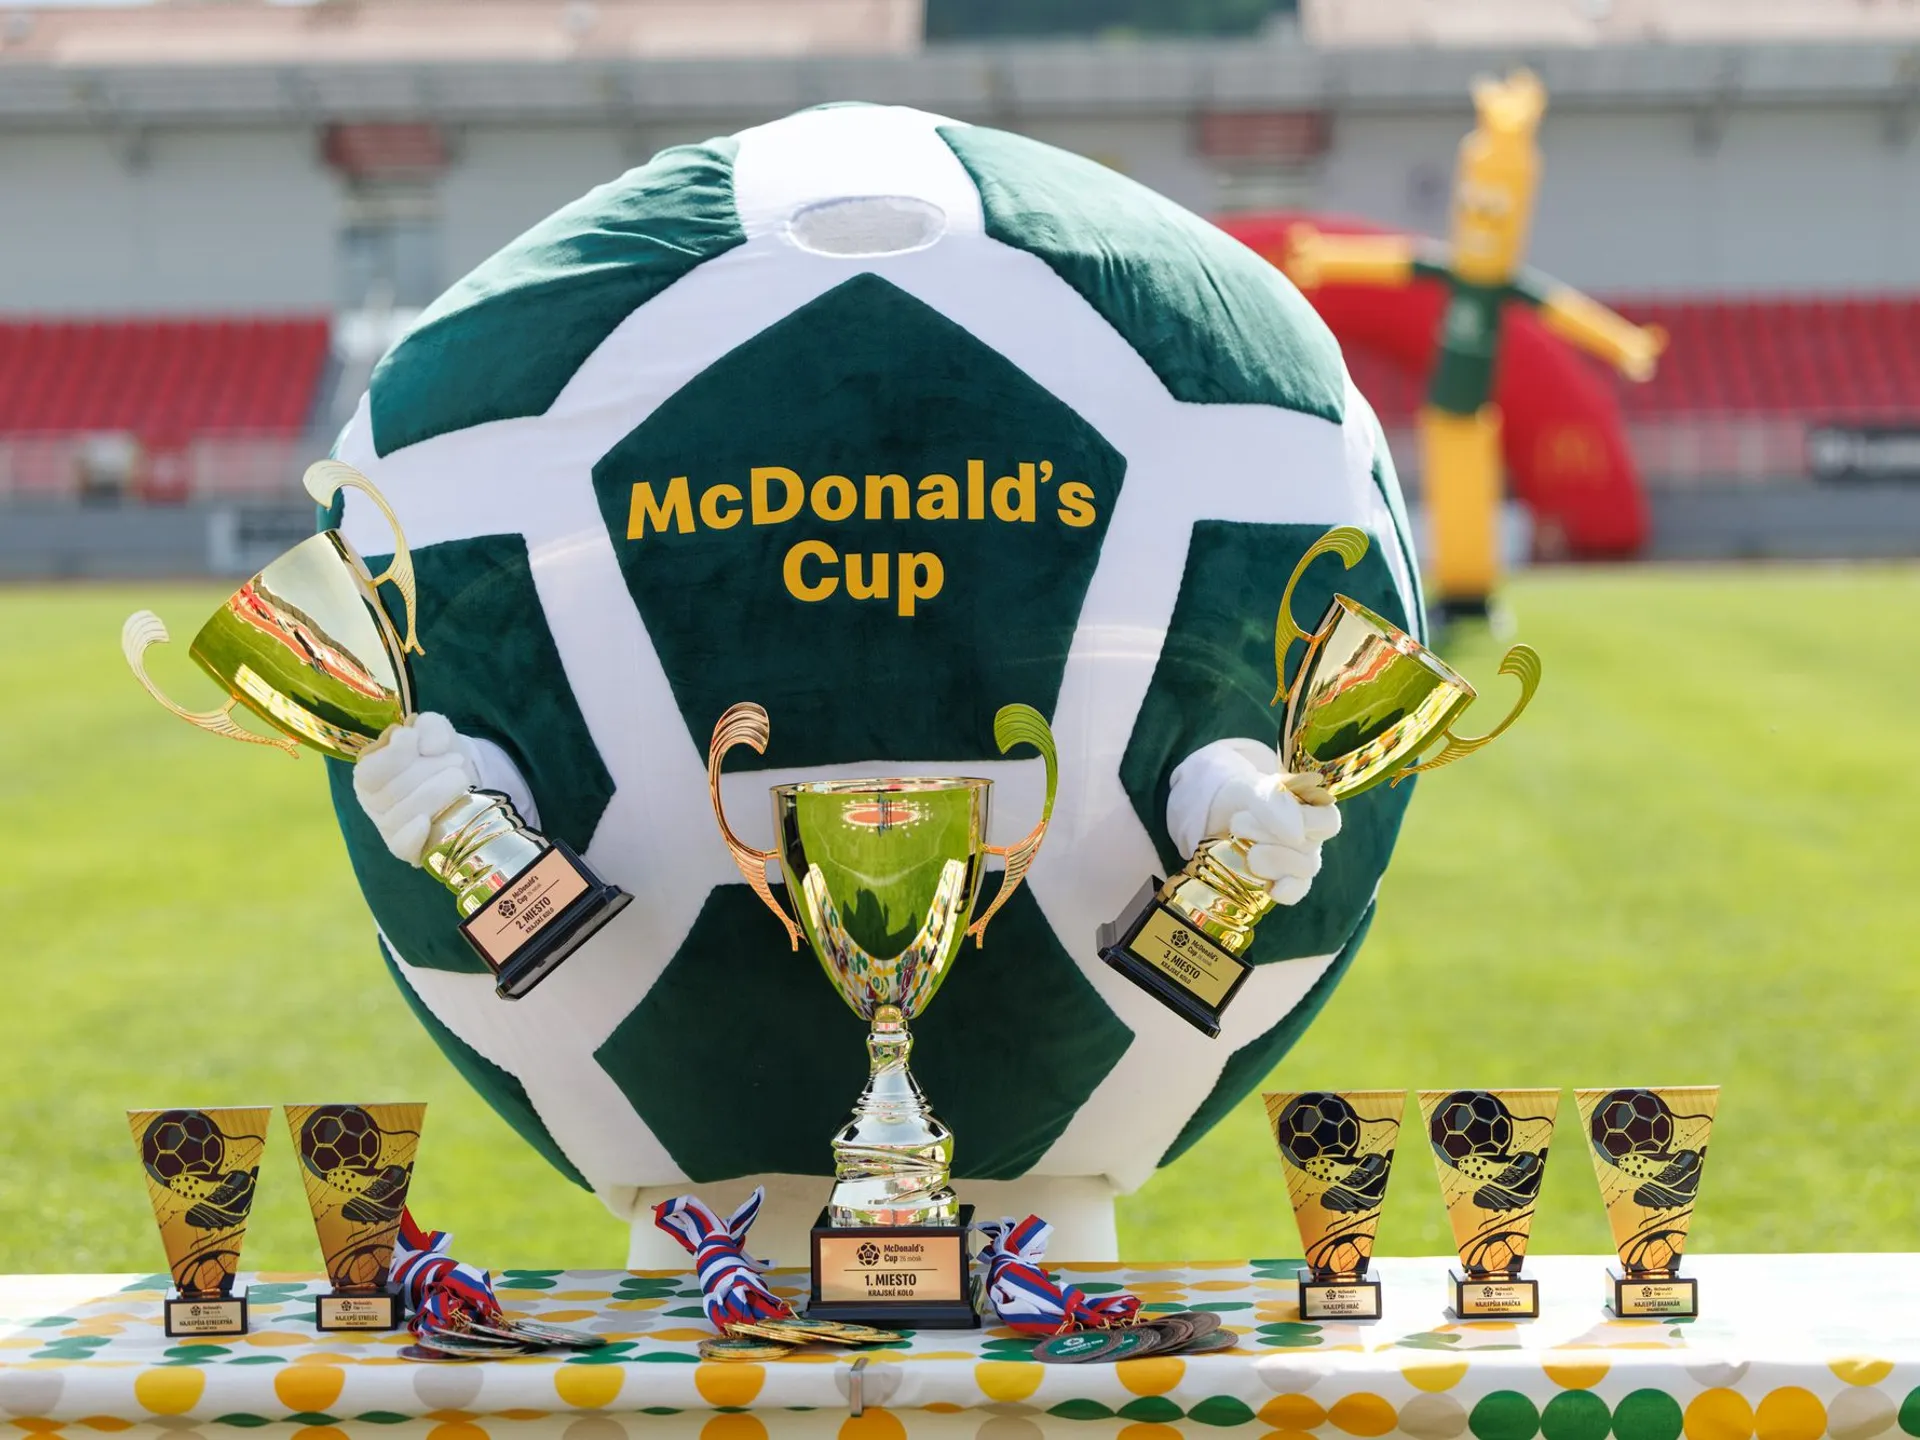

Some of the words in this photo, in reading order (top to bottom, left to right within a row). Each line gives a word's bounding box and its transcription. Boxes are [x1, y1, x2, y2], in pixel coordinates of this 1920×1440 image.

[627, 459, 1097, 540] McDonald's
[783, 539, 945, 617] Cup
[517, 894, 529, 906] Cup
[516, 918, 526, 930] 2.
[524, 896, 552, 924] MIESTO
[1187, 945, 1198, 957] Cup
[1163, 950, 1171, 961] 3.
[1172, 954, 1201, 980] MIESTO
[883, 1243, 925, 1253] McDonald's
[883, 1253, 898, 1264] Cup
[865, 1274, 874, 1286] 1.
[876, 1274, 917, 1286] MIESTO
[868, 1287, 896, 1297] KRAJSKÉ
[897, 1289, 914, 1297] KOLO
